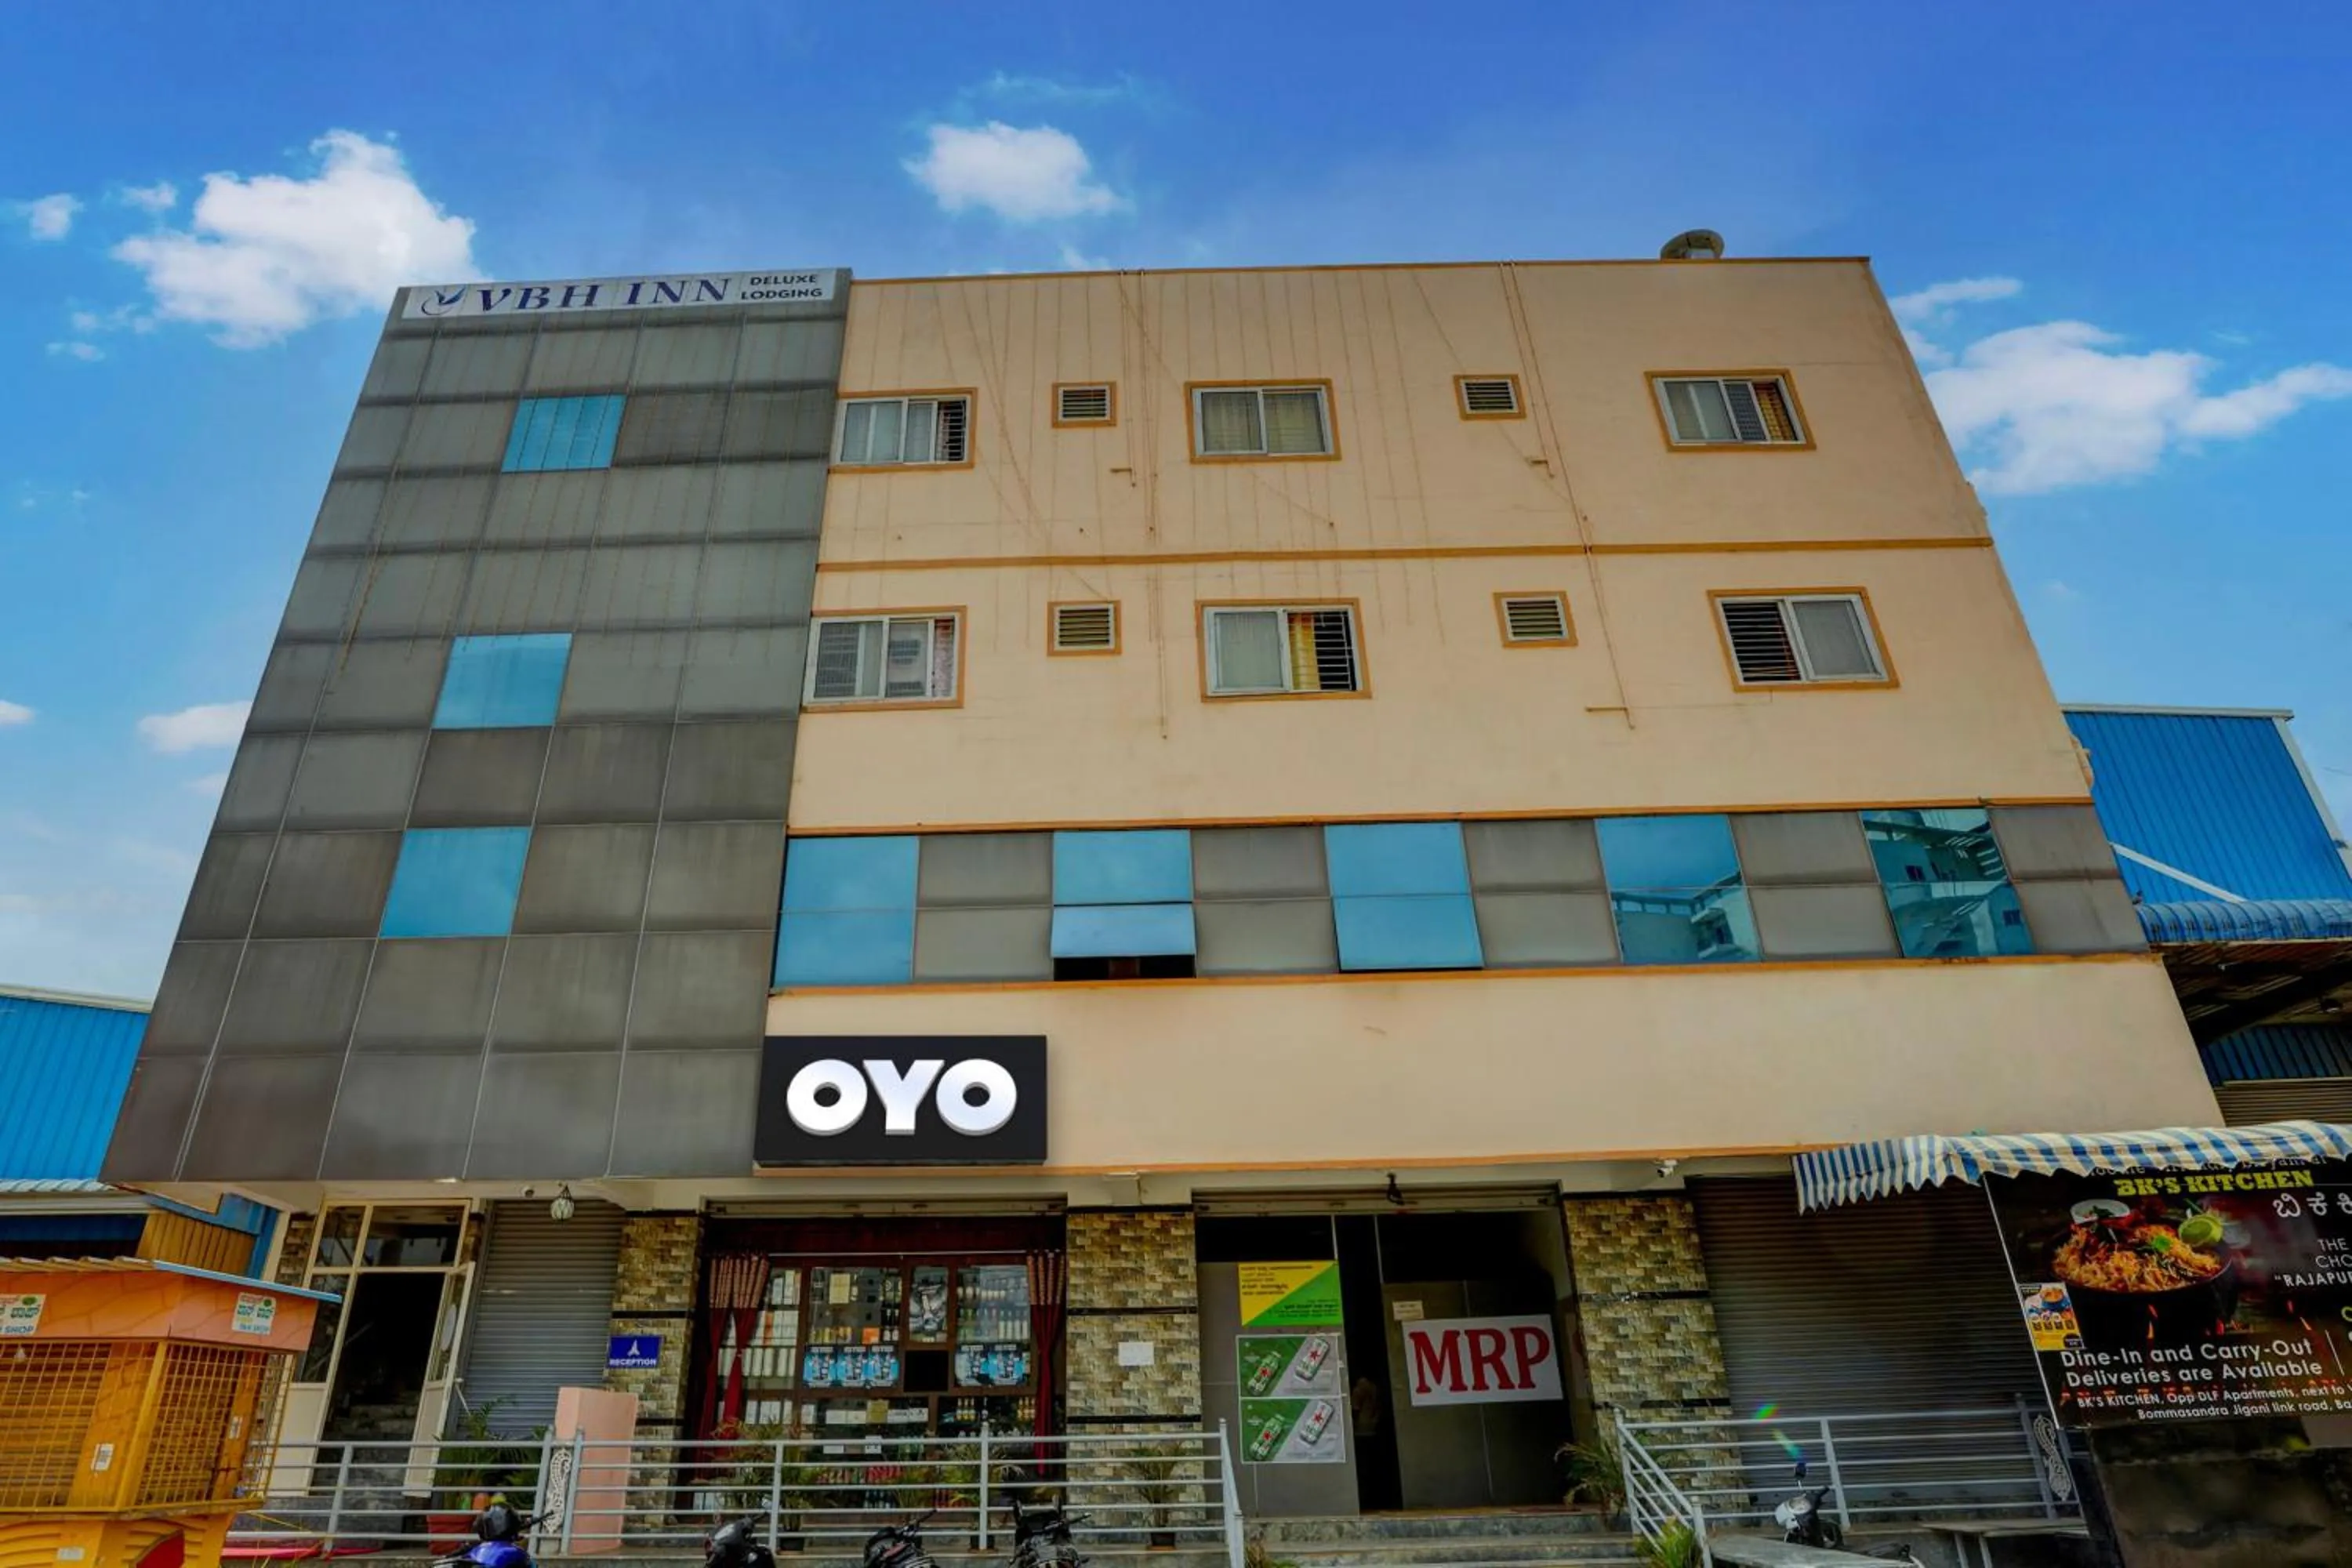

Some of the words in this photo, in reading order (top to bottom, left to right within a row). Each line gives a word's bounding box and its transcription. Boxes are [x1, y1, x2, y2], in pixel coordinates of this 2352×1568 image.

[750, 274, 818, 285] DELUXE
[477, 284, 602, 311] VBH
[626, 278, 731, 305] INN
[741, 289, 822, 299] LODGING
[786, 1058, 1017, 1136] OYO
[2184, 1170, 2314, 1192] KITCHEN
[2318, 1238, 2349, 1251] THE
[609, 1358, 657, 1367] RECEPTION
[1409, 1327, 1551, 1393] MRP
[2060, 1348, 2143, 1367] Dine-In
[2150, 1345, 2194, 1363] and
[2200, 1338, 2312, 1361] Carry-Out
[2066, 1368, 2171, 1387] Deliveries
[2179, 1369, 2213, 1381] are
[2222, 1359, 2322, 1380] Available
[2166, 1391, 2195, 1405] Opp
[2302, 1386, 2328, 1396] next
[2332, 1384, 2345, 1395] to
[2138, 1406, 2230, 1420] Bommasandra
[2273, 1400, 2296, 1412] link
